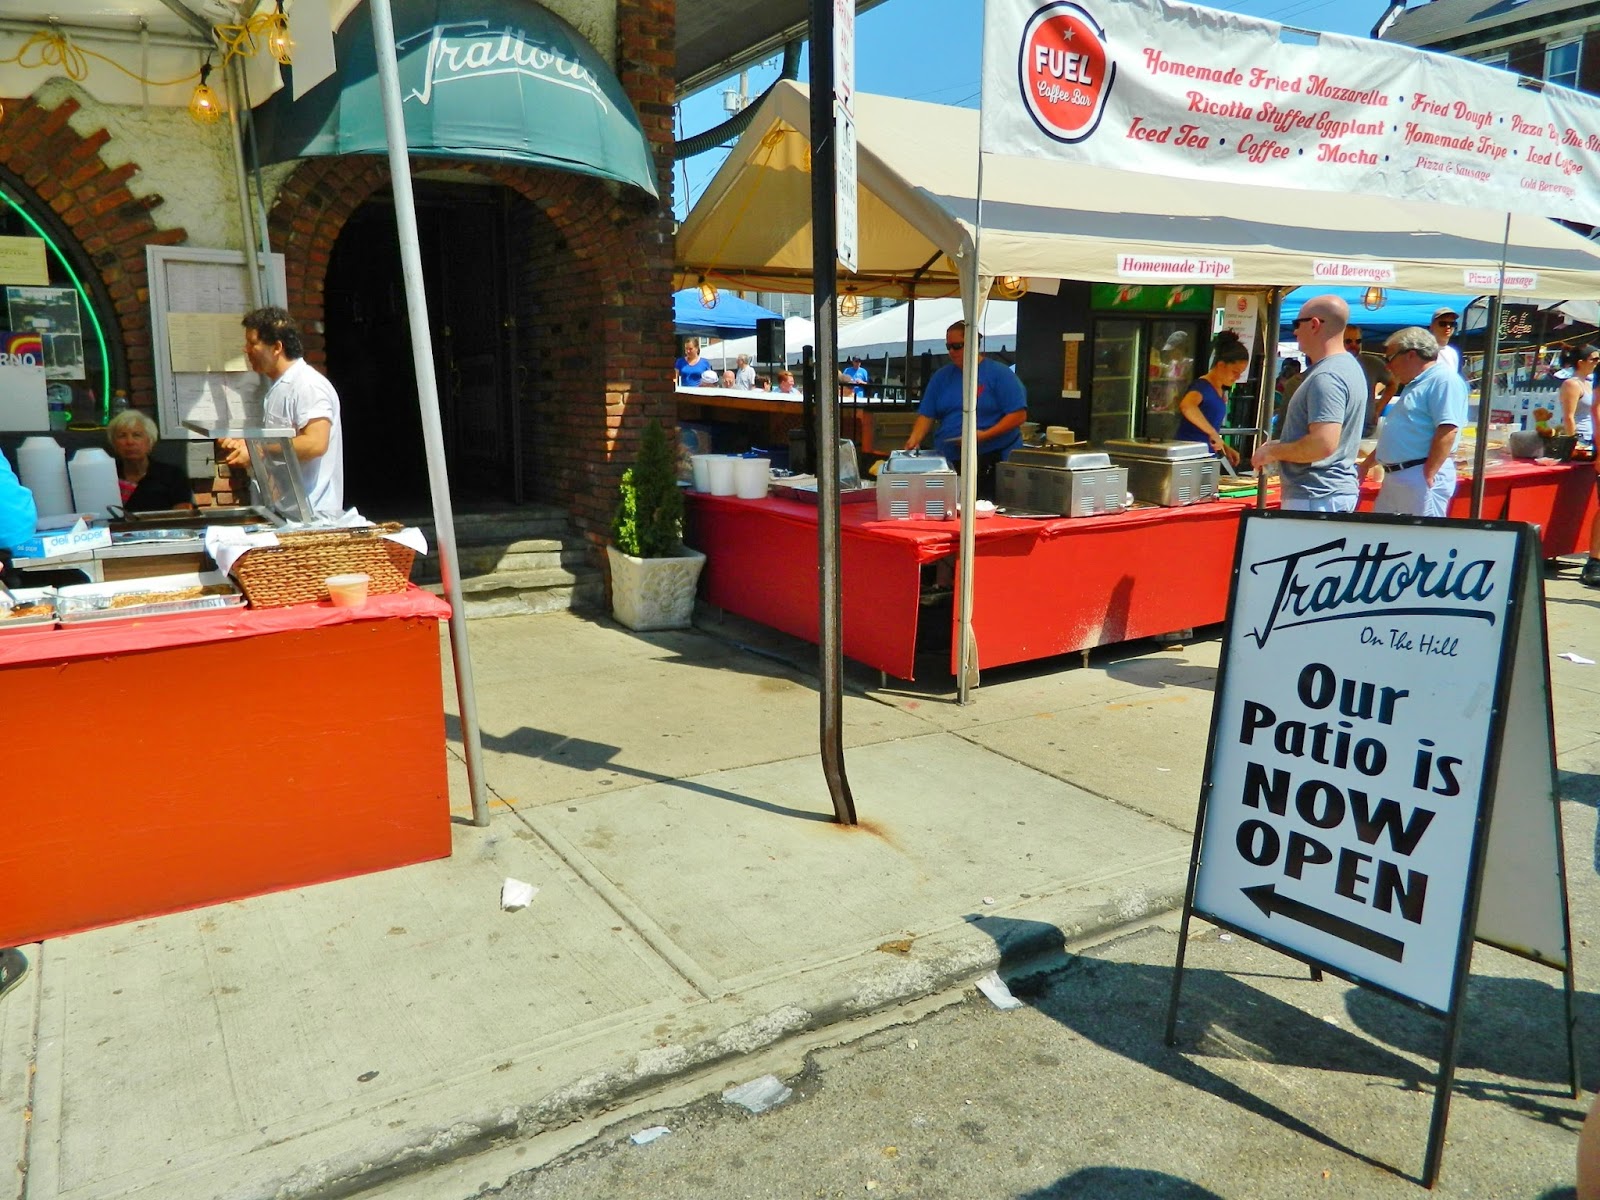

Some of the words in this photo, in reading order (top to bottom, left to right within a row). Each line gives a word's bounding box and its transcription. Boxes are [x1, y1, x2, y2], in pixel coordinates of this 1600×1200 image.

[396, 20, 602, 105] Trattoria
[1035, 44, 1092, 86] FUEL
[1037, 80, 1070, 104] Coffee
[1071, 88, 1092, 107] Bar
[1143, 47, 1243, 87] Homemade
[1249, 67, 1302, 93] Fried
[1306, 74, 1389, 107] Mozzarella
[1411, 92, 1450, 117] Fried
[1453, 101, 1493, 130] Dough
[1511, 114, 1543, 138] Pizza
[1562, 128, 1583, 148] The
[1126, 116, 1173, 143] Iced
[1174, 124, 1210, 149] Tea
[1237, 134, 1290, 163] Coffee
[1317, 143, 1378, 165] Mocha
[1186, 90, 1253, 120] Ricotta
[1256, 101, 1316, 132] Stuffed
[1316, 111, 1385, 138] Eggplant
[1405, 121, 1474, 152] Homemade
[1476, 136, 1508, 161] Tripe
[1526, 145, 1552, 166] Iced
[1415, 156, 1444, 172] Pizza
[1446, 161, 1453, 173] &
[1455, 163, 1491, 182] Sausage
[1520, 176, 1537, 190] Cold
[1123, 257, 1195, 273] Homemade
[1199, 260, 1231, 277] Tripe
[1316, 262, 1338, 277] Cold
[1342, 264, 1391, 281] Beverages
[1469, 272, 1492, 284] Pizza
[1501, 274, 1534, 288] ausage
[51, 533, 69, 547] deli
[74, 529, 104, 545] paper
[1244, 537, 1496, 649] Trattoria
[1360, 626, 1383, 646] On
[1390, 628, 1413, 651] The
[1419, 635, 1459, 657] Hill
[1296, 662, 1409, 725] Our
[1239, 700, 1387, 777] Patio
[1413, 739, 1462, 796] is
[1242, 761, 1436, 856] NOW
[1235, 818, 1428, 925] OPEN
